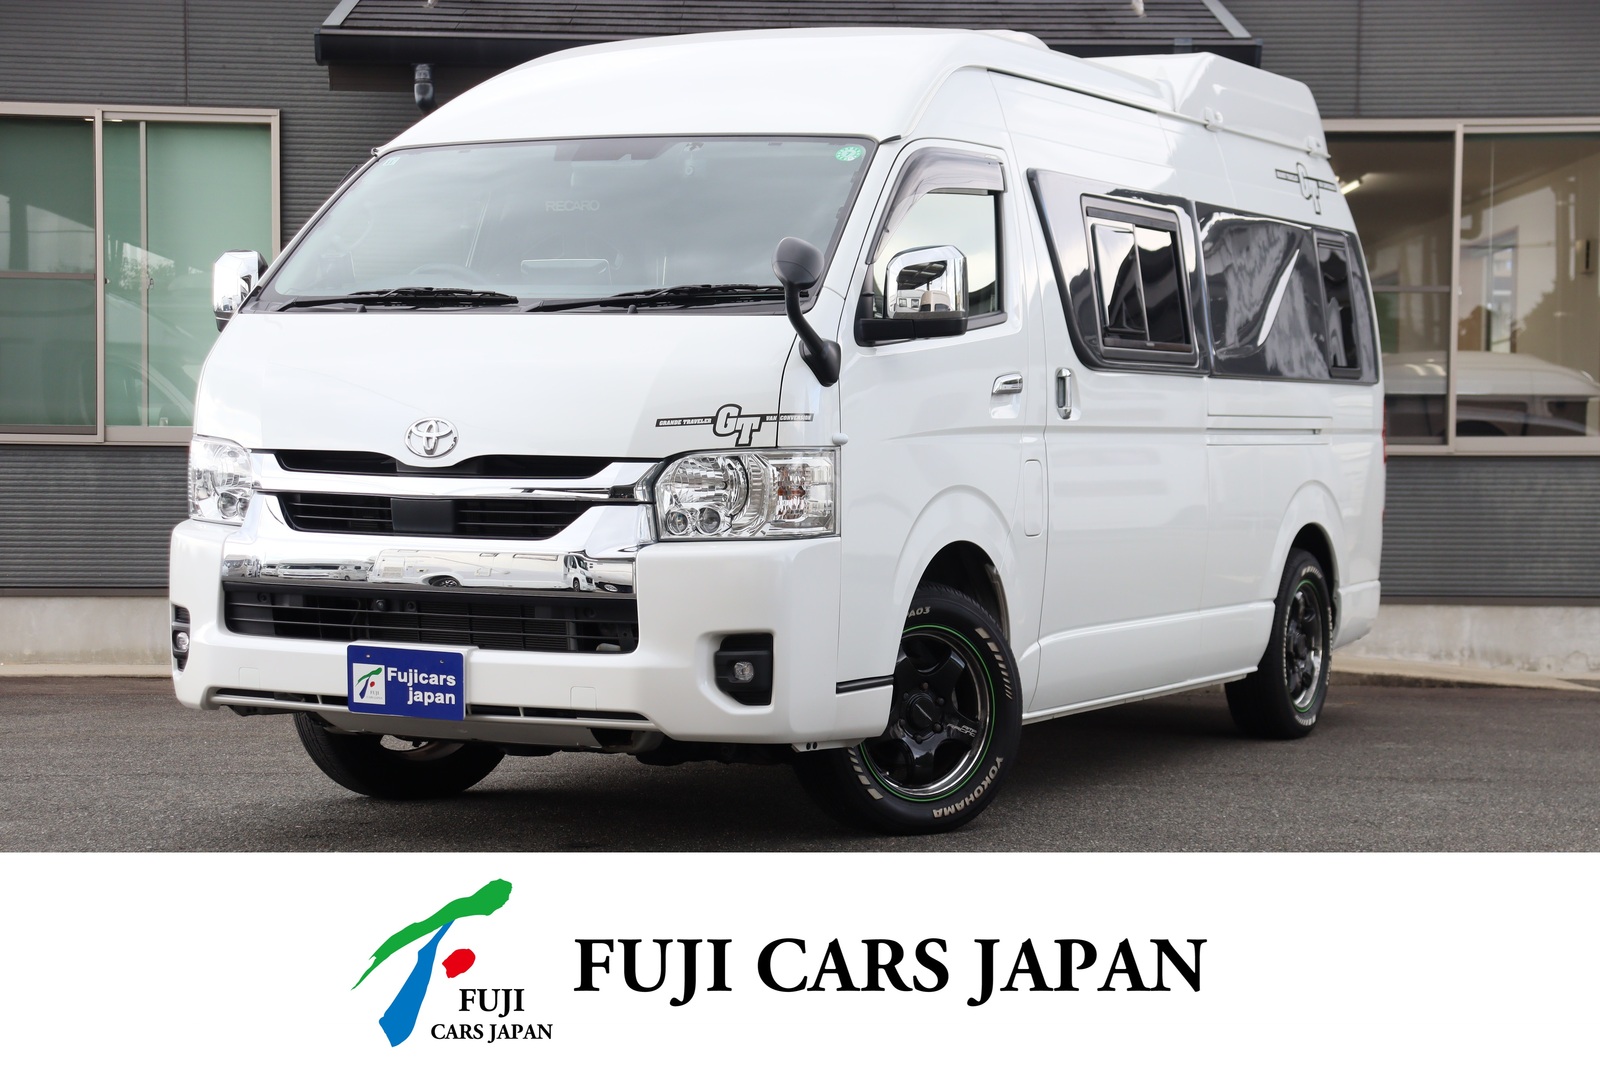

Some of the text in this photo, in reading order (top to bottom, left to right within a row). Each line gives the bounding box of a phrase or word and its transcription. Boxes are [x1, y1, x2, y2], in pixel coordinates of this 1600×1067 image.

[545, 200, 600, 212] RECARO
[683, 417, 712, 425] TRAVELER
[713, 403, 763, 447] GT
[907, 606, 930, 618] A03
[387, 667, 456, 687] Fujicars
[407, 687, 456, 706] japan
[931, 756, 1004, 819] YOKOHAMA
